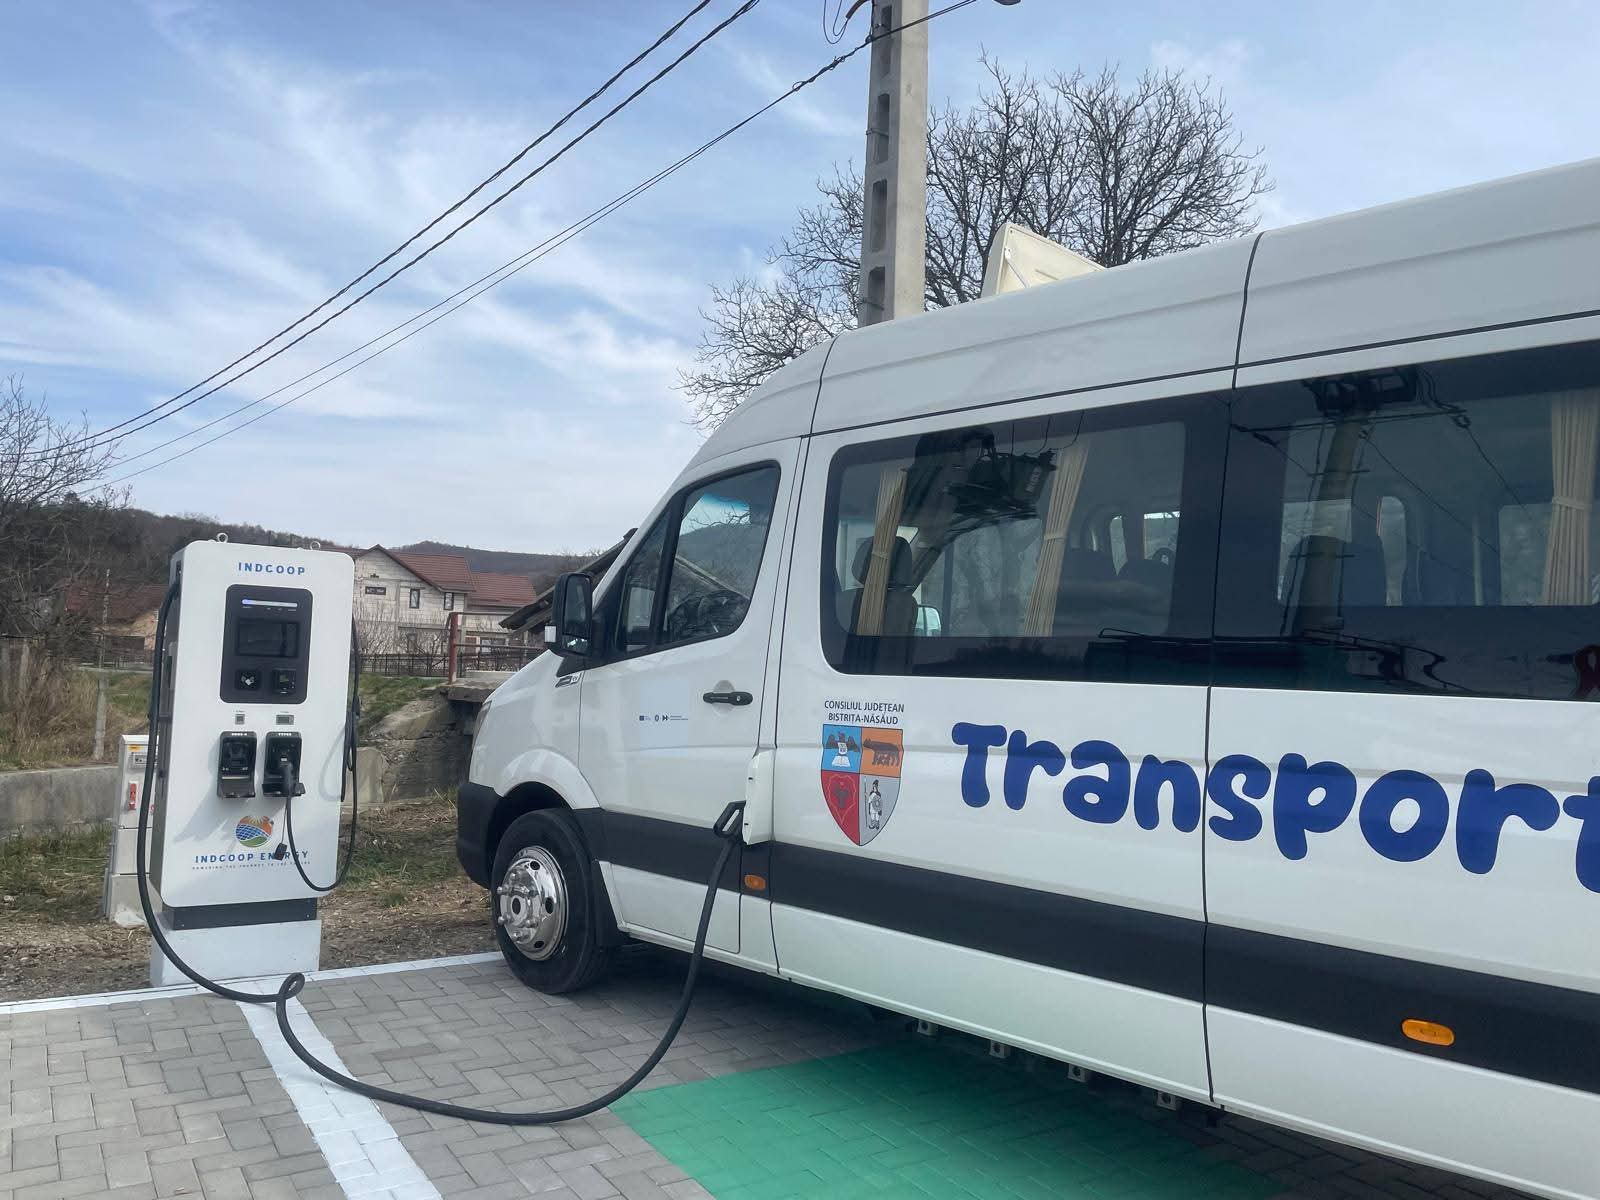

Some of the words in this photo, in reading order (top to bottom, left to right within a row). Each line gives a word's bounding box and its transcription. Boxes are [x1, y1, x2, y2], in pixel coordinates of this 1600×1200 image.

[238, 562, 306, 575] INDCOOP
[824, 700, 862, 711] CONSILIUL
[952, 723, 1600, 892] Transport
[195, 853, 254, 863] INDCOOP
